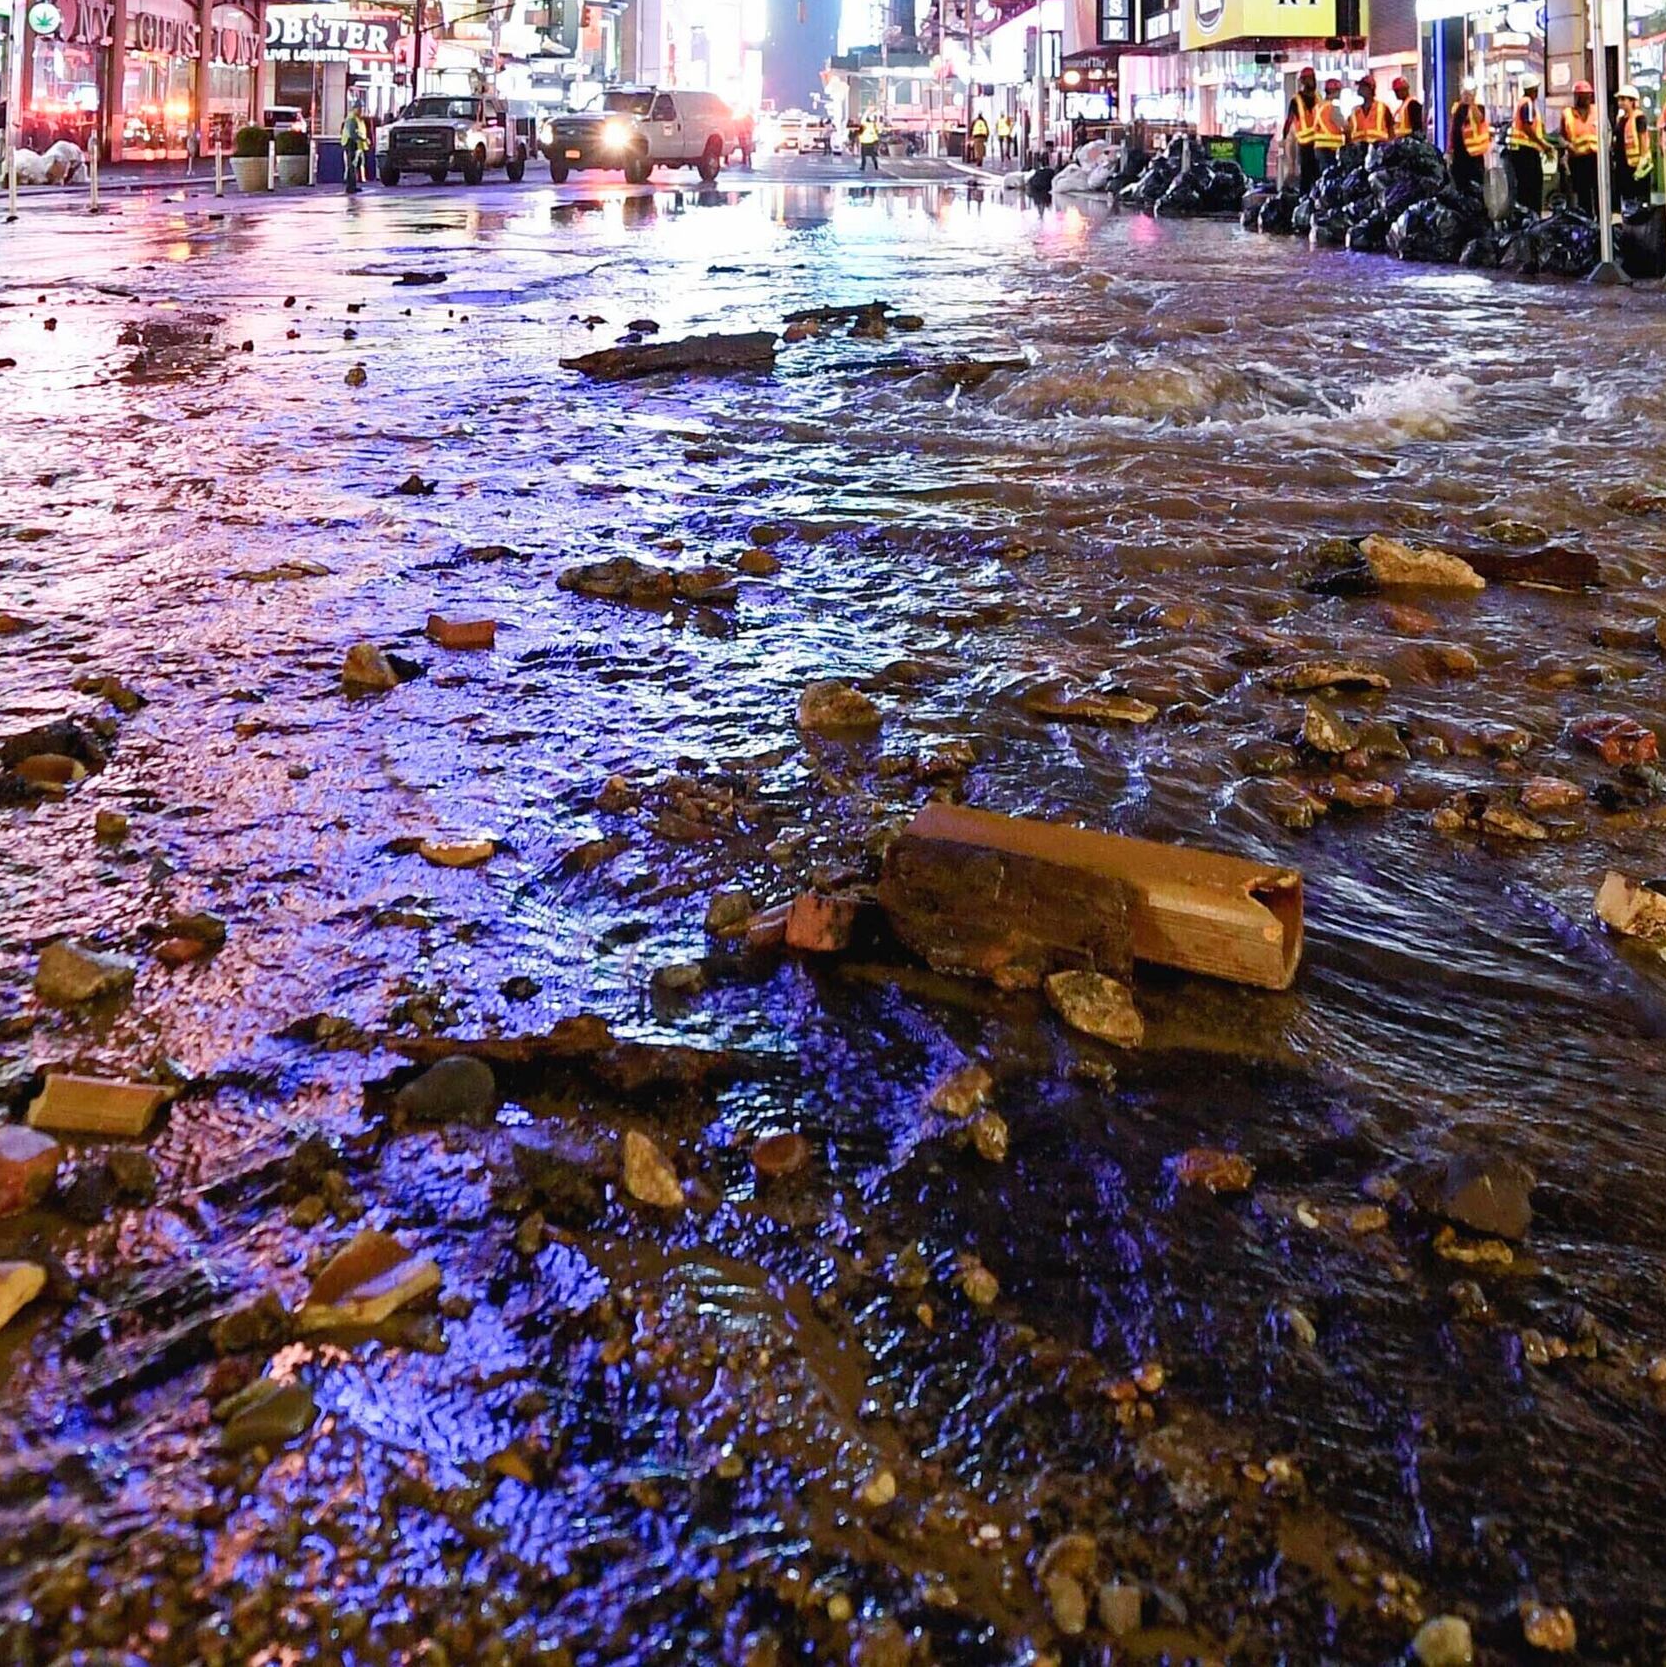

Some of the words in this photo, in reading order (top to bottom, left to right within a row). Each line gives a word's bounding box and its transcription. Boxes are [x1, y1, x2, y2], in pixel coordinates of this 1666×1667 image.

[138, 12, 201, 57] GIFTS
[264, 16, 389, 53] OBSTER
[264, 49, 291, 61] LIVE
